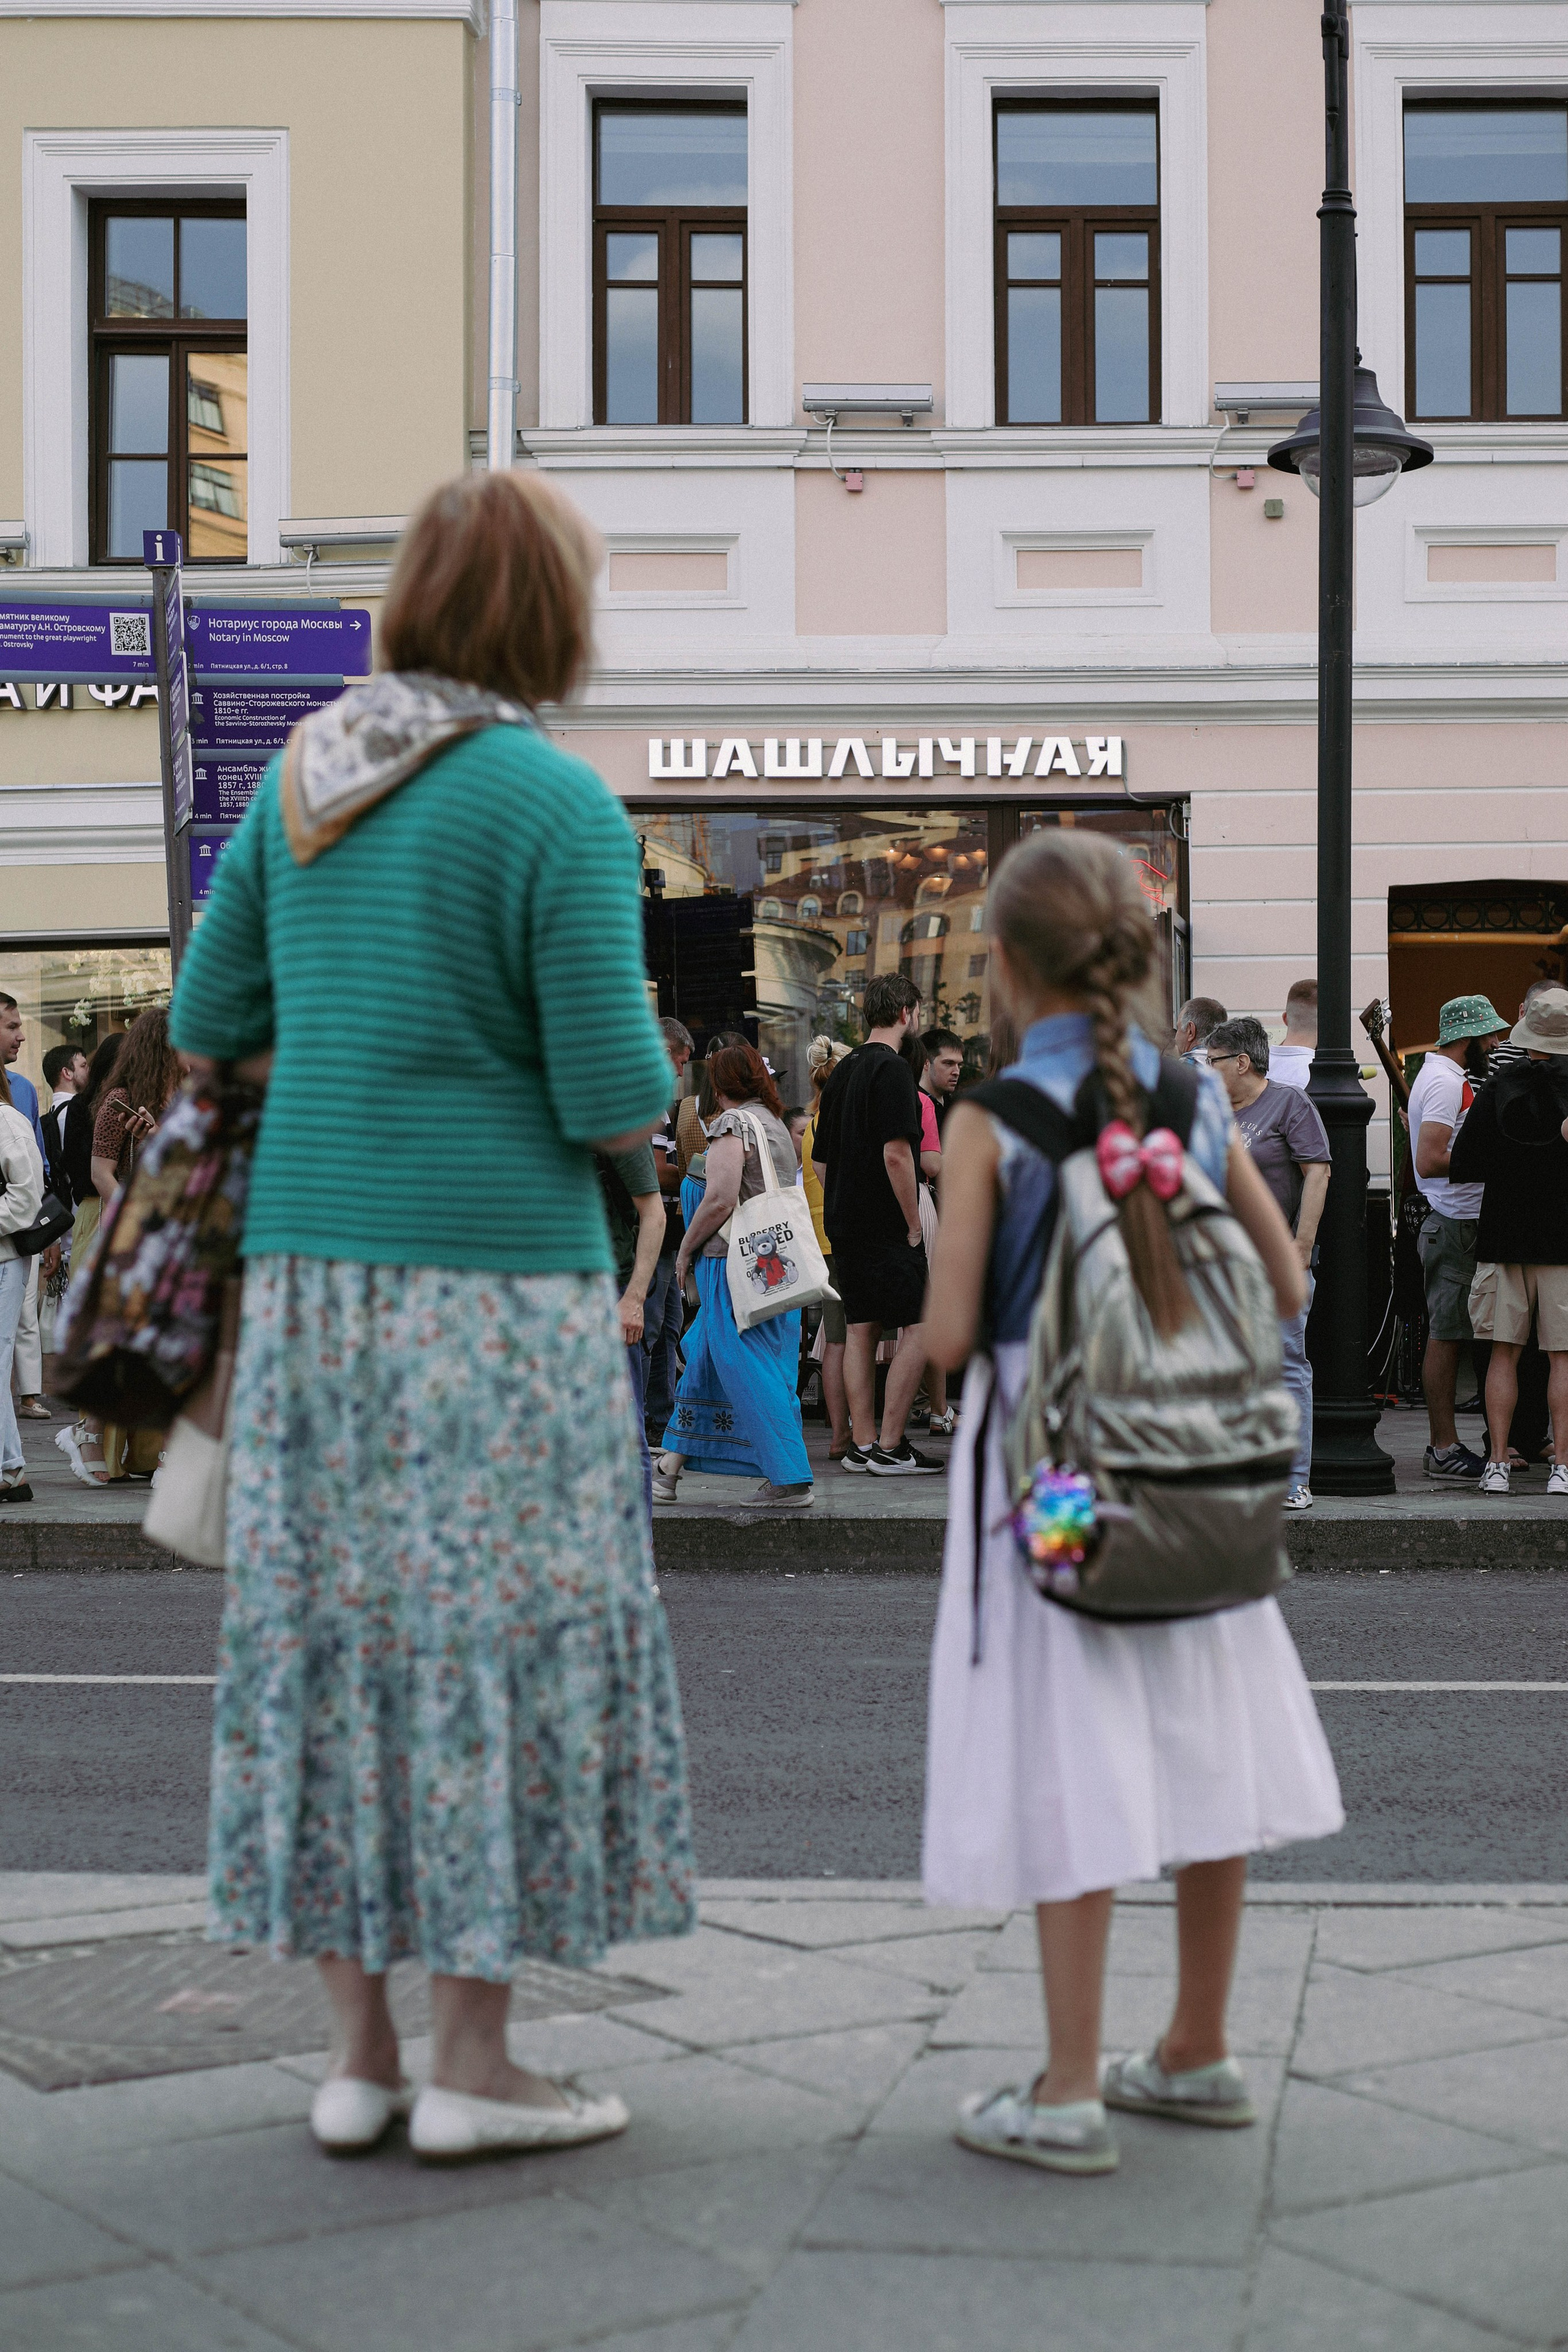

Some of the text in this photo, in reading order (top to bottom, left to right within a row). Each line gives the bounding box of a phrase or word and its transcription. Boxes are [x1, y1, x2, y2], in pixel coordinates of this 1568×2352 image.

[31, 614, 70, 624] великому
[53, 624, 106, 634] Островскому
[208, 618, 342, 631] Нотариус города Москвы
[63, 635, 97, 643] playwright
[209, 633, 290, 644] Notary in Moscow
[271, 692, 311, 700] постройка
[213, 699, 305, 708] Саввино-Сторожевского
[648, 736, 1123, 778] ШАШЛЫЧНАЯ
